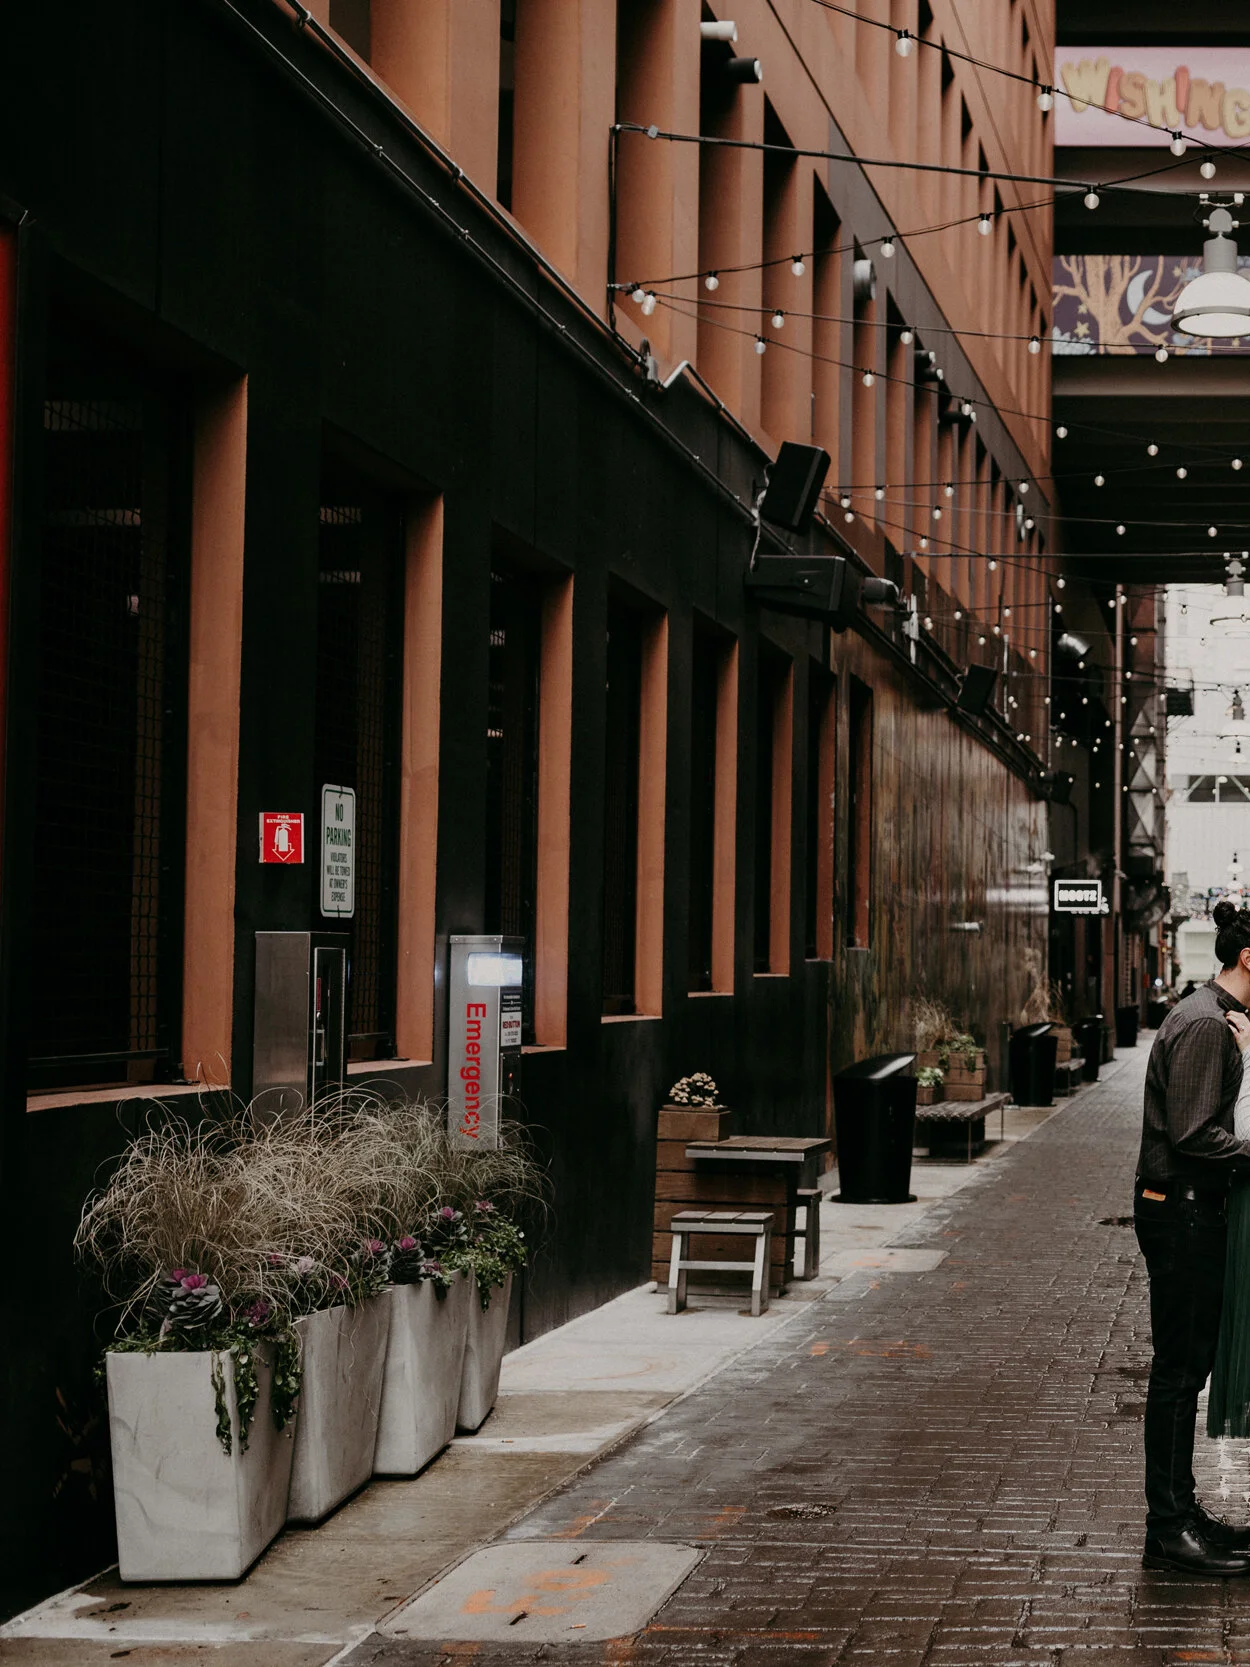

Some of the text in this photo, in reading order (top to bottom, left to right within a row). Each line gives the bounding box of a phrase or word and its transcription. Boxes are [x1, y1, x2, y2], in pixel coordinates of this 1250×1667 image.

[335, 803, 344, 822] NO
[326, 826, 351, 847] PARKING
[460, 1003, 487, 1140] Emergency
